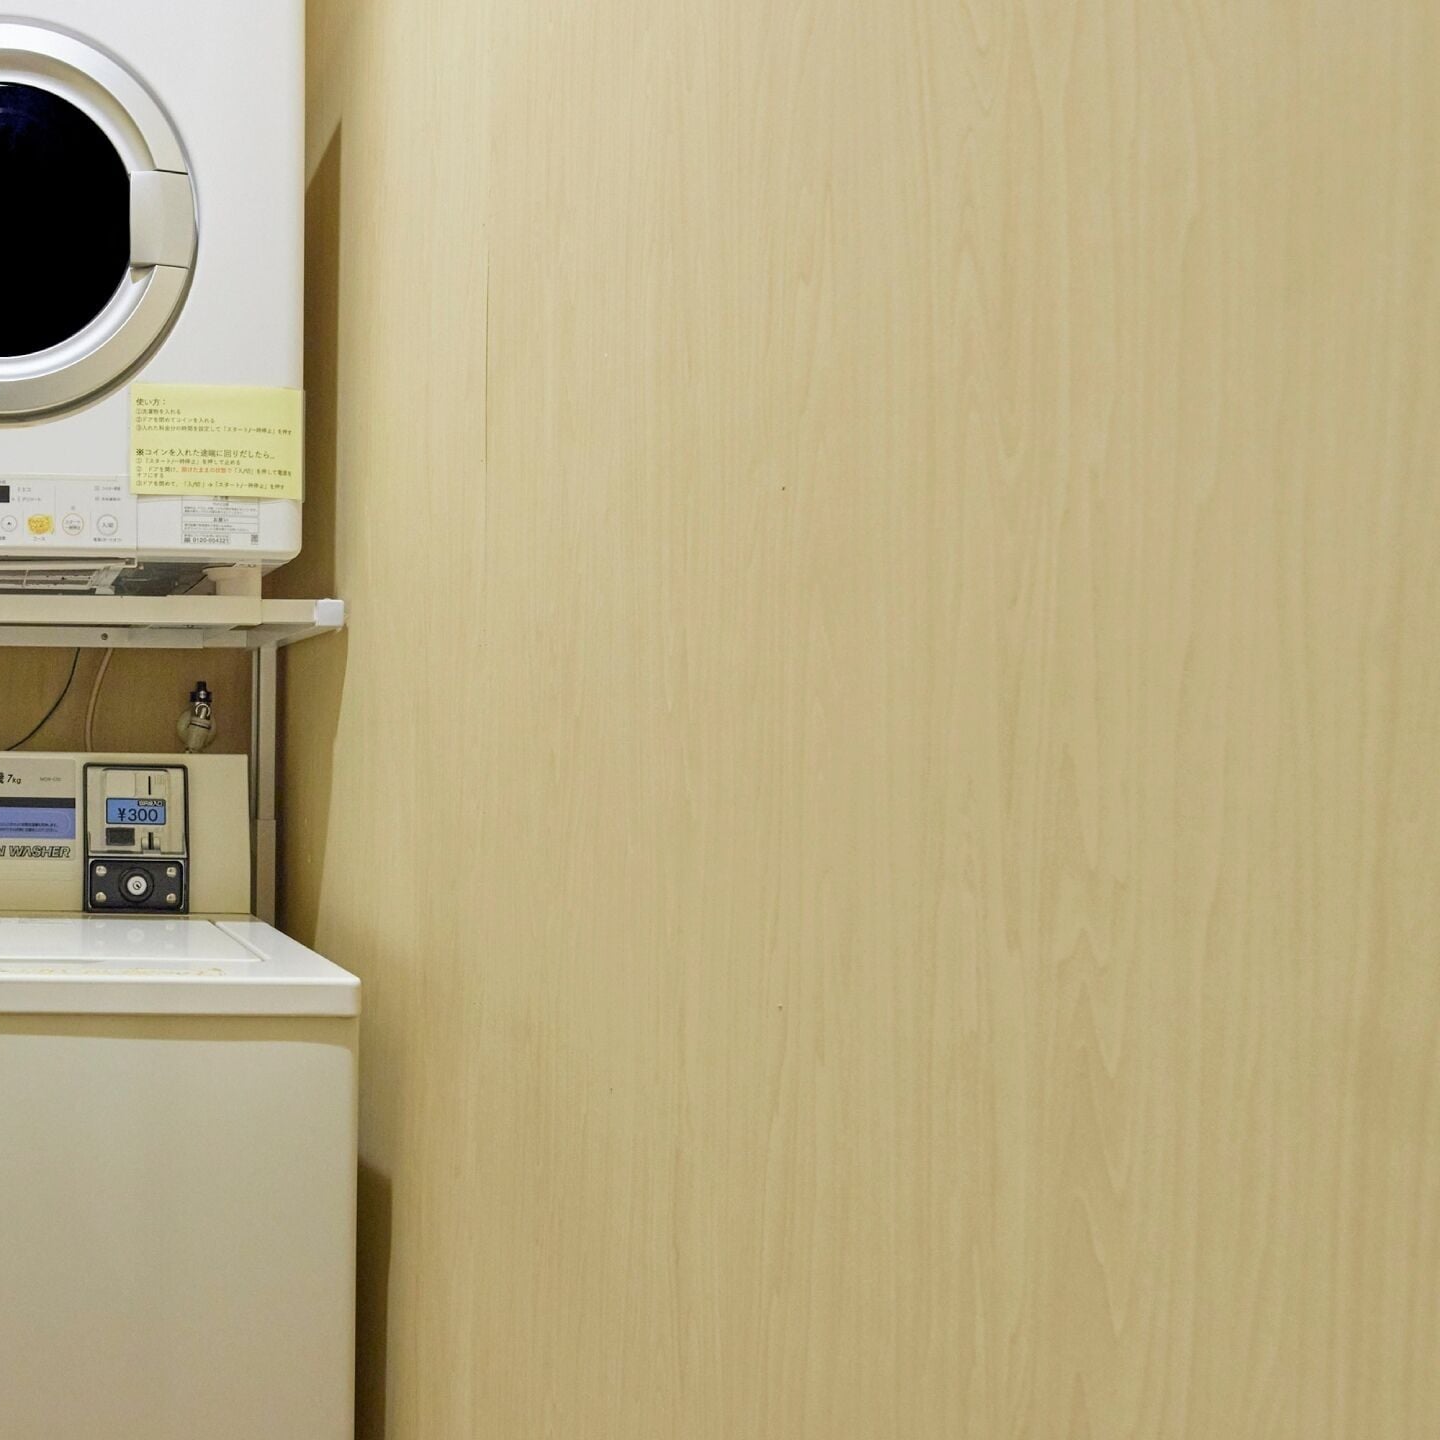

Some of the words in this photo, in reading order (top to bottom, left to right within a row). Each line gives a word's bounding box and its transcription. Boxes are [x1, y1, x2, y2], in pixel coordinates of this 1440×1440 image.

[7, 774, 22, 785] 7kg
[118, 808, 158, 822] ¥300
[9, 845, 71, 858] WASHER
